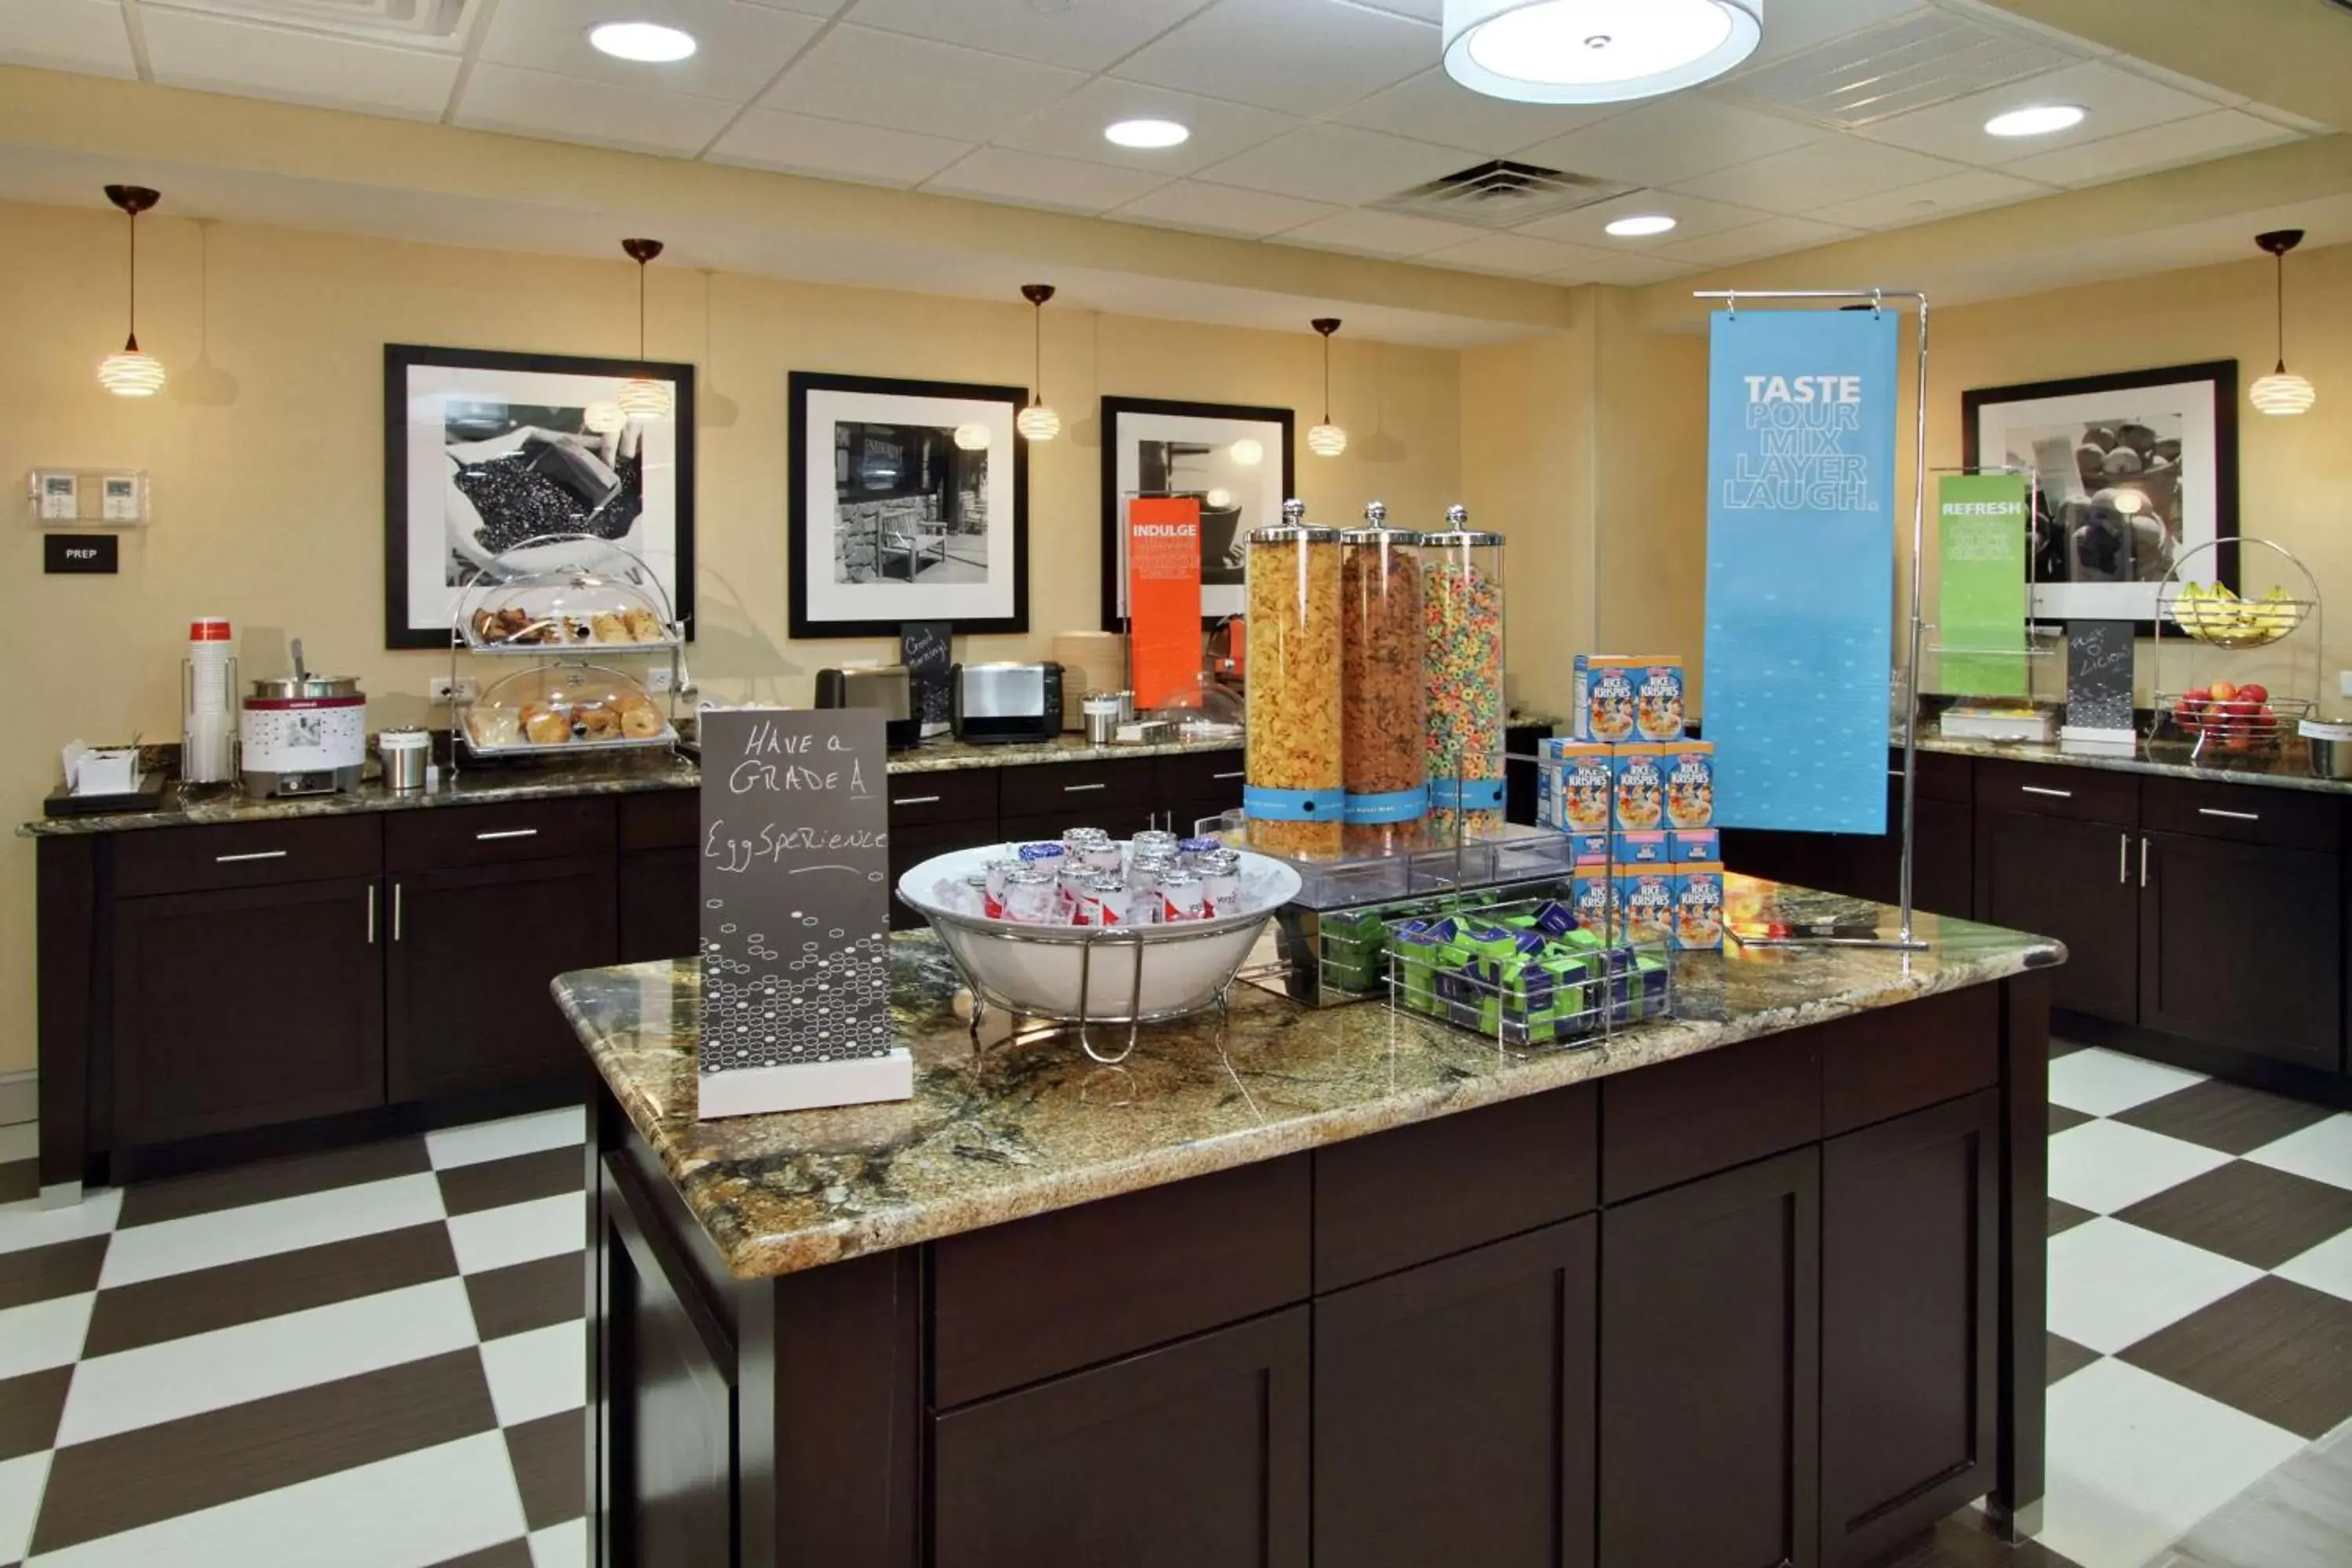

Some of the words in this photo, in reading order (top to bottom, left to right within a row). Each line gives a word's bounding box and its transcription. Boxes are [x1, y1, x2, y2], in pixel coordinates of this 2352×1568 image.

[1744, 376, 1861, 403] TASTE
[1746, 401, 1860, 430] POUR
[1760, 428, 1843, 456] MIX
[1737, 453, 1867, 483] LAYER
[1723, 479, 1879, 511] LAUGH.
[1943, 502, 2021, 515] REFRESH
[1133, 524, 1197, 536] INDULGE
[66, 549, 97, 559] PREP
[851, 757, 866, 794] A
